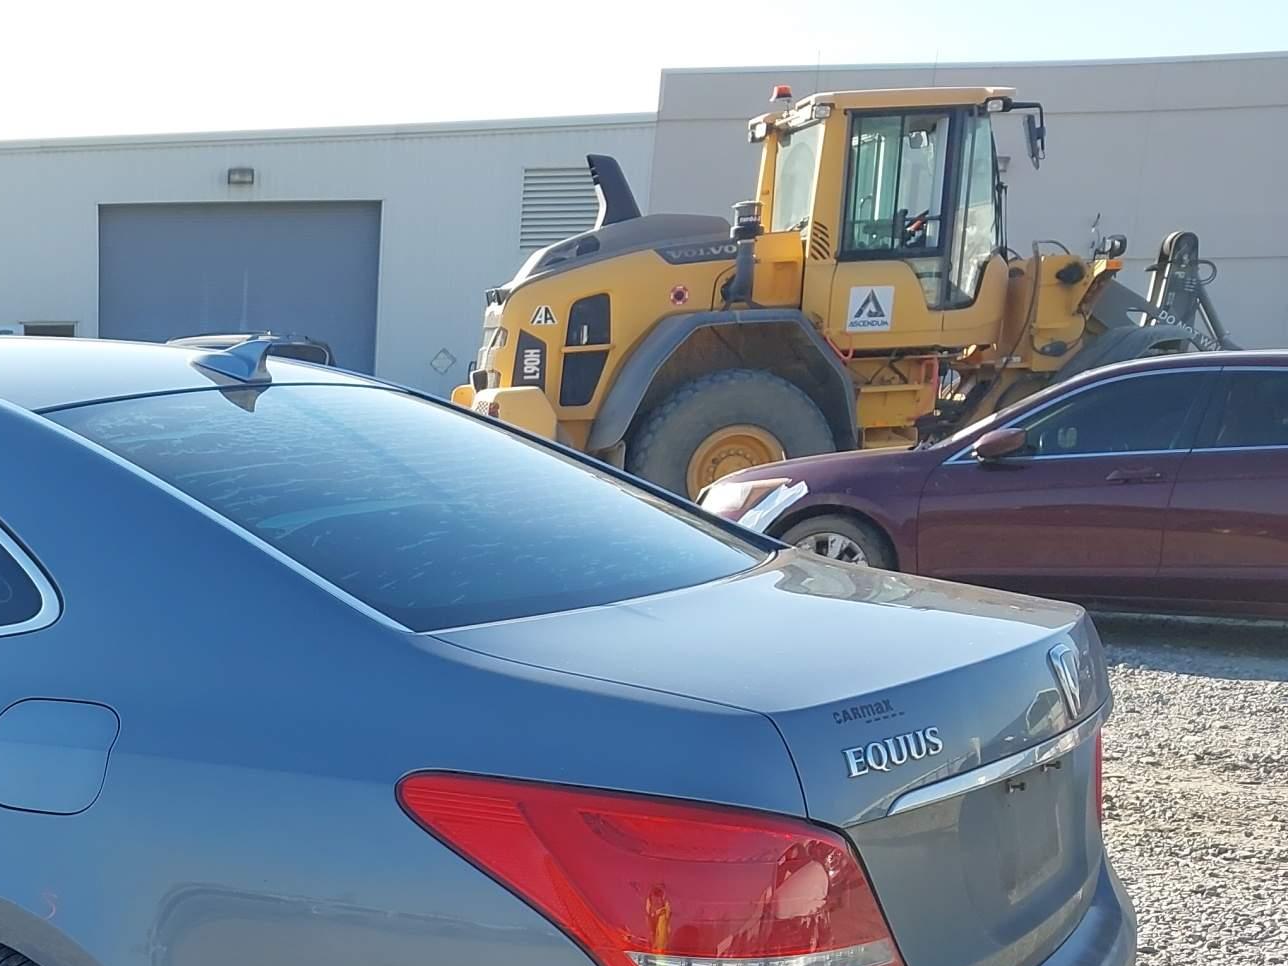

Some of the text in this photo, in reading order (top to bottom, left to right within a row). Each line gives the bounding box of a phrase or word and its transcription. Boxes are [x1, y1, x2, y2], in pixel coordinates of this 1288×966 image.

[666, 243, 737, 259] VOLVO
[1158, 310, 1176, 325] DO
[523, 348, 541, 380] L90H
[841, 726, 943, 778] EQUUS
